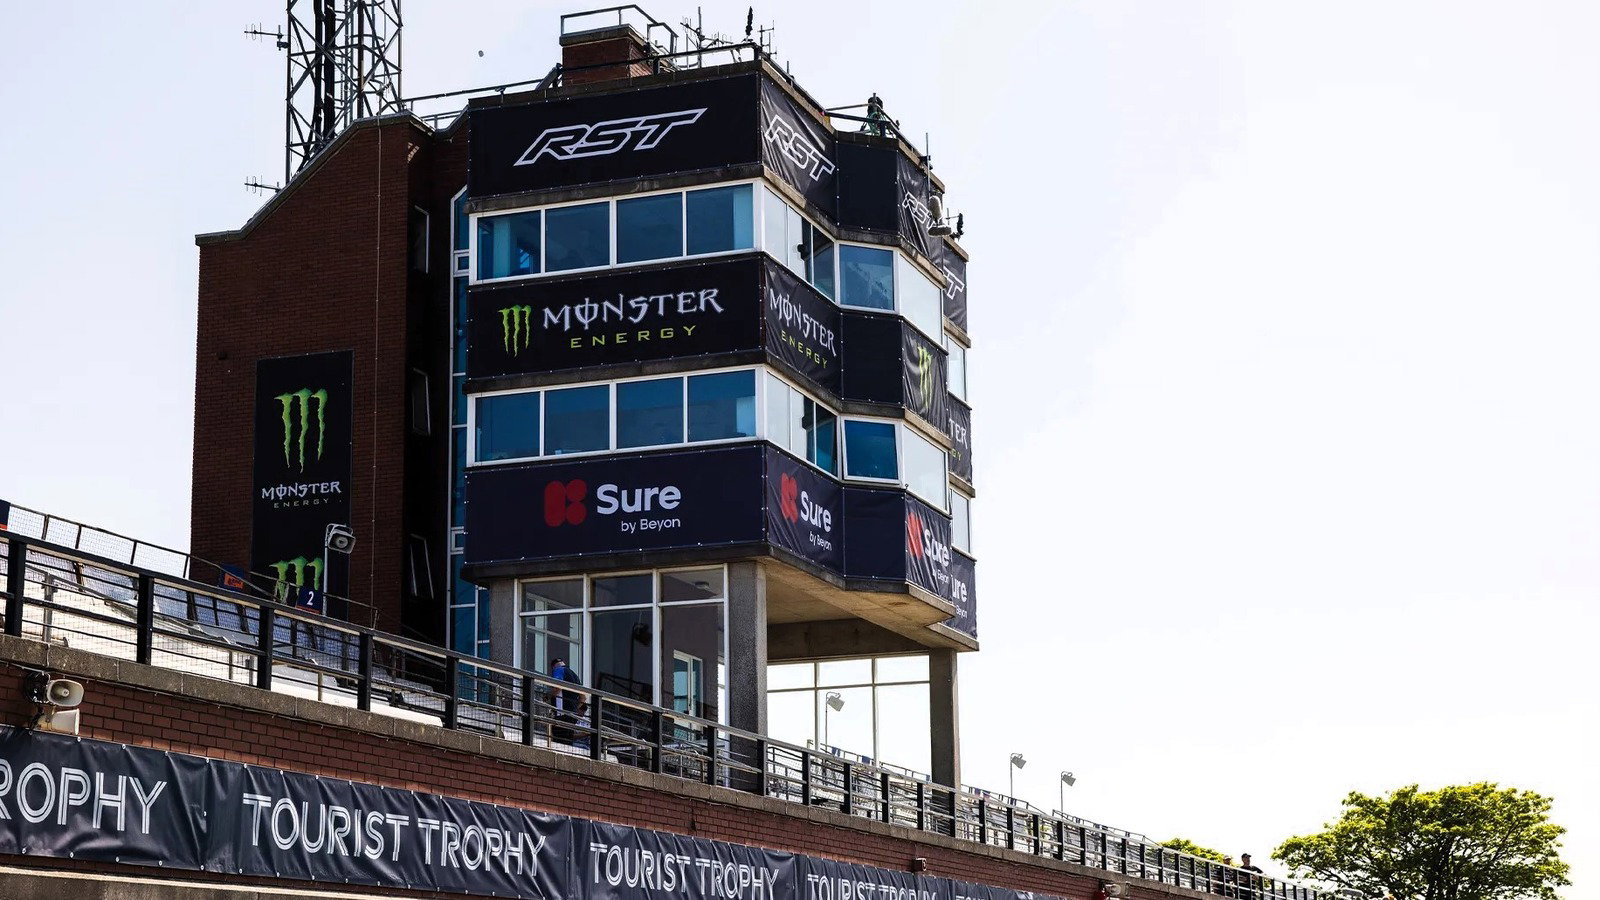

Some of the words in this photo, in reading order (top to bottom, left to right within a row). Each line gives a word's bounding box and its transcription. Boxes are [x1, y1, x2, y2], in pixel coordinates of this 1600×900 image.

[513, 107, 708, 167] RST
[765, 114, 836, 181] RST
[541, 288, 725, 332] MONSTER
[570, 325, 697, 349] ENERGY
[781, 330, 829, 370] ENERGY
[261, 481, 342, 501] MONSTER
[273, 498, 329, 509] ENERGY
[596, 483, 682, 515] Sure
[621, 520, 636, 534] by
[640, 517, 681, 532] Beyon
[800, 490, 832, 533] Sure
[809, 530, 817, 546] by
[924, 528, 949, 567] Sure
[306, 591, 315, 606] 2
[243, 792, 410, 862] TOURIST
[417, 817, 547, 877] TROPHY
[590, 841, 691, 892] TOURIST
[695, 857, 780, 900] TROPHY
